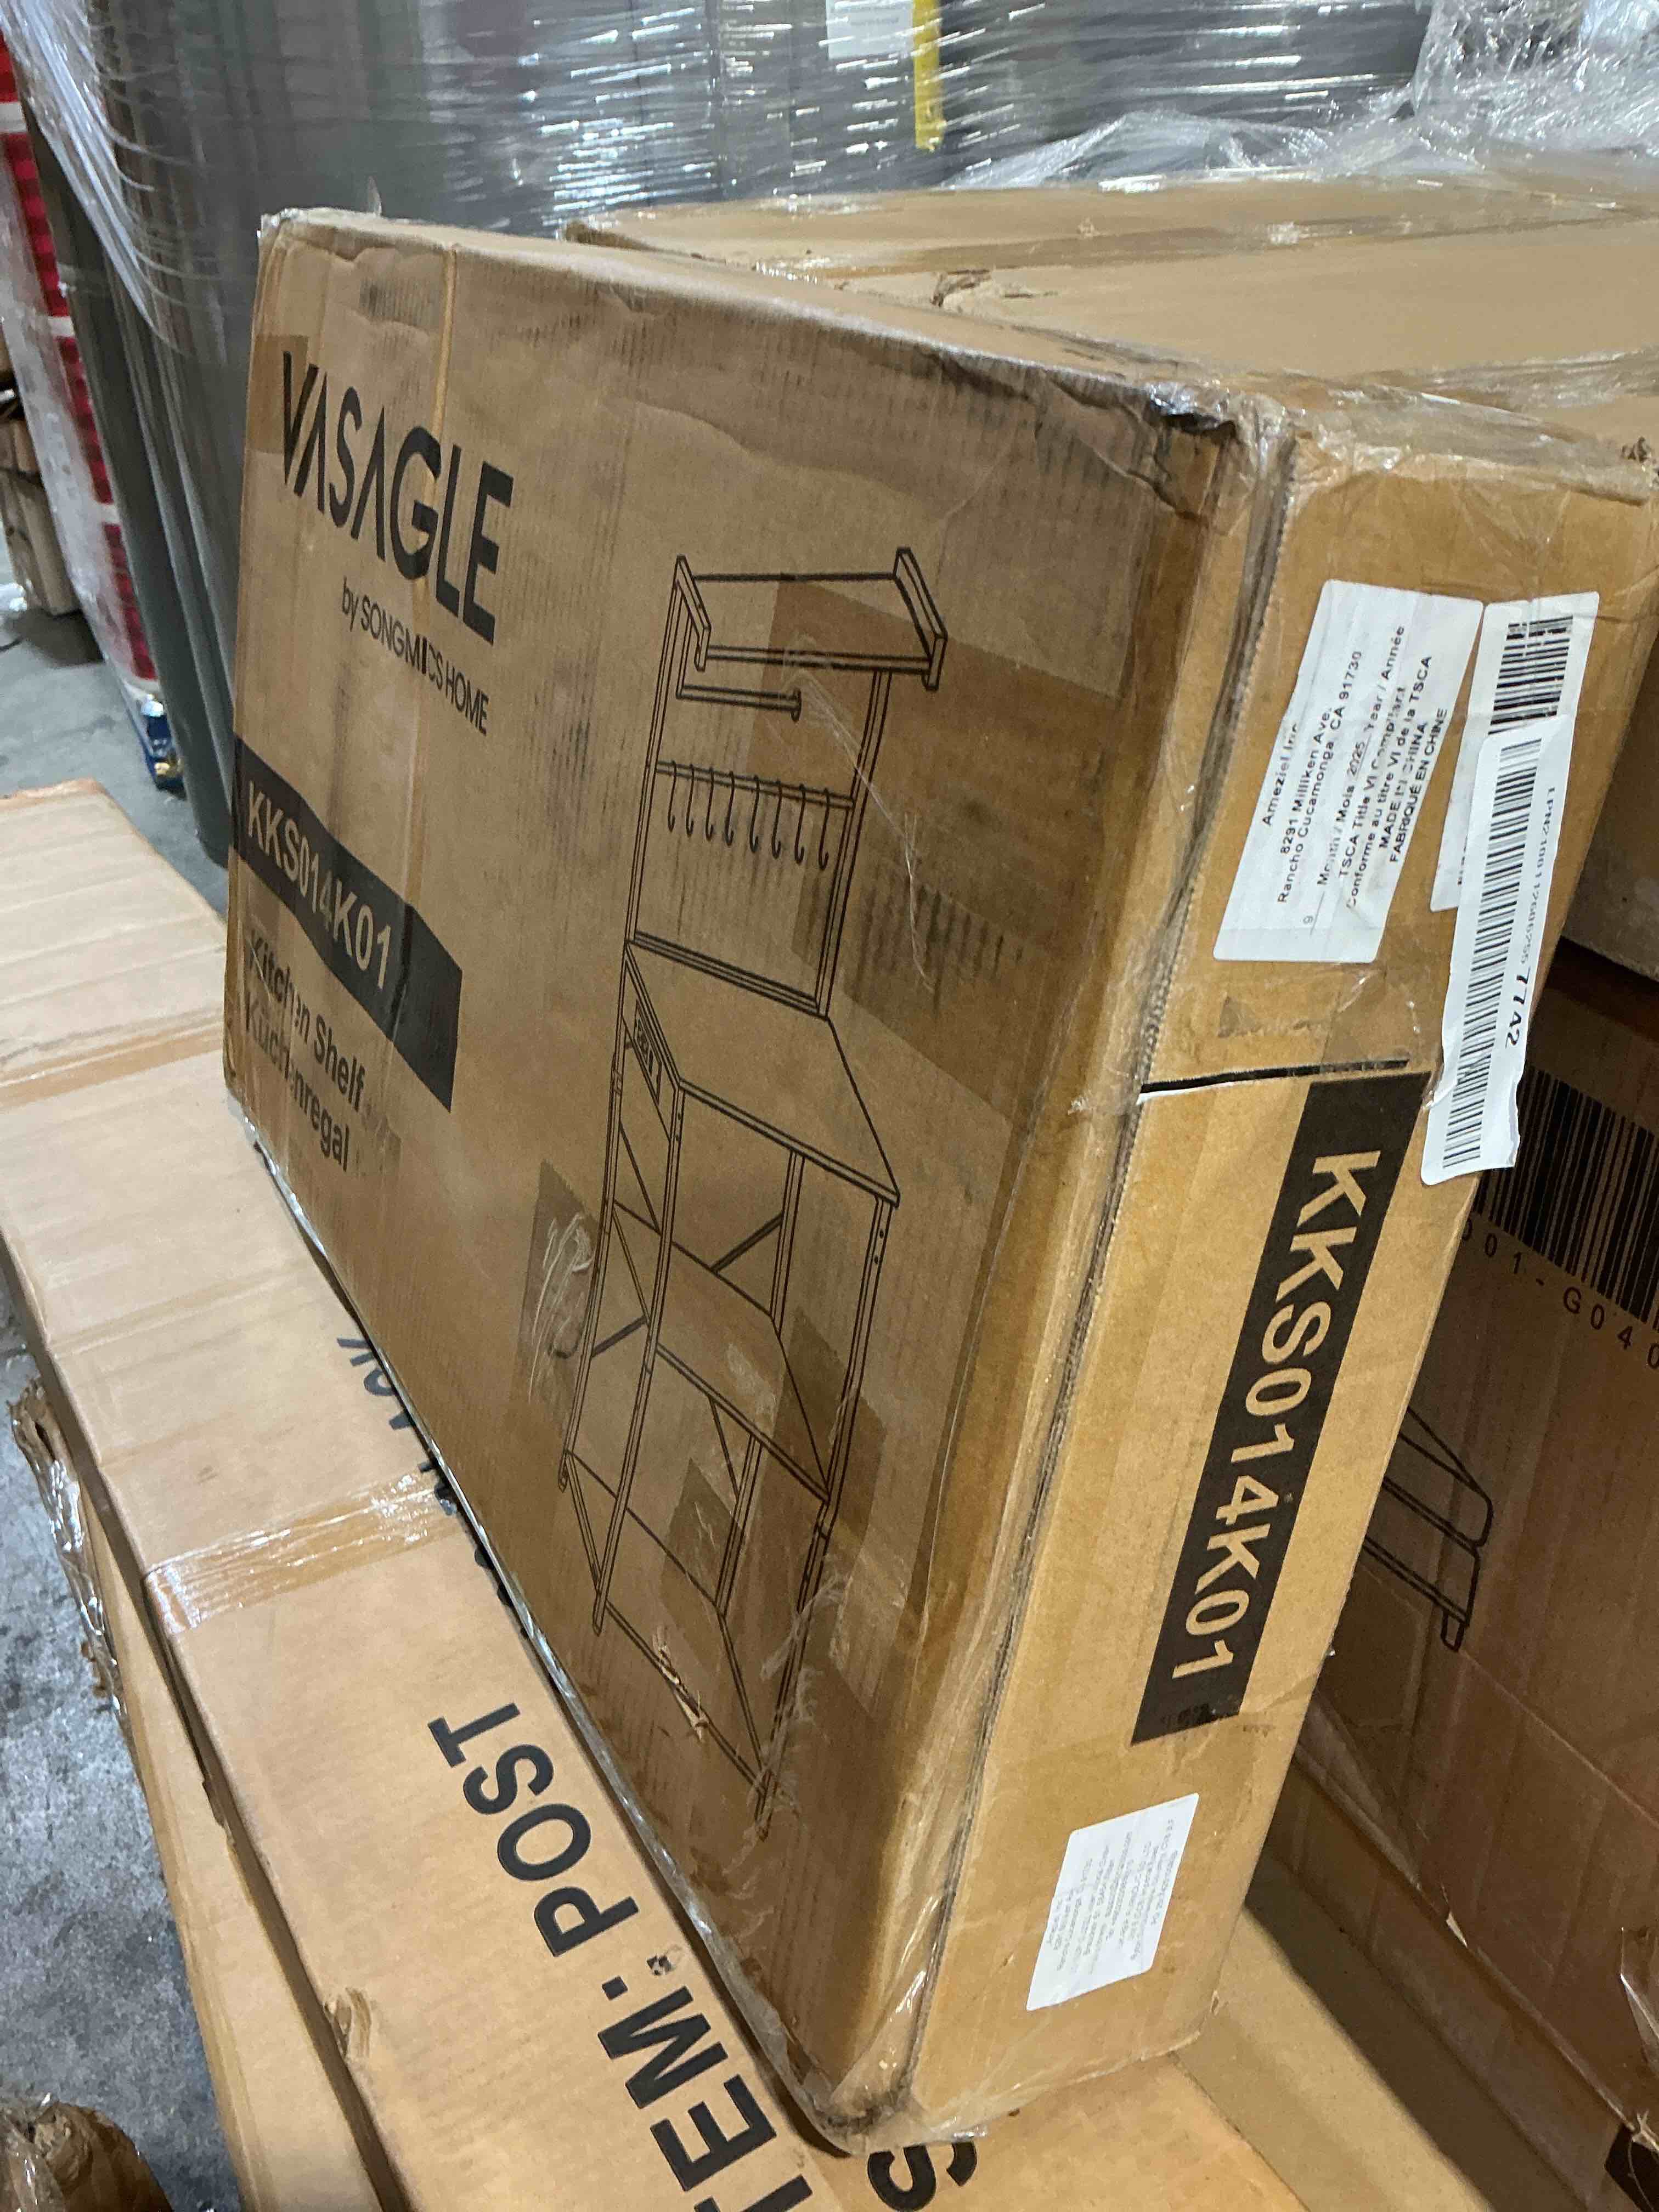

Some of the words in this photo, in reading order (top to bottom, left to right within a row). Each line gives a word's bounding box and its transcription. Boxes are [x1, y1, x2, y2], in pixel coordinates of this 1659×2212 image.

[283, 351, 513, 645] VASAGLE
[342, 578, 359, 633] by
[444, 661, 489, 736] HOME
[1380, 625, 1404, 680] Année
[1409, 655, 1432, 702] TSCA
[1278, 843, 1304, 902] Rancho
[1330, 706, 1345, 730] CA
[1339, 650, 1362, 700] 91730
[1389, 751, 1401, 766] VI
[1396, 727, 1409, 746] de
[1415, 760, 1429, 780] EN
[1424, 707, 1447, 755] CHINE
[1261, 756, 1291, 825] Ameziel
[1281, 819, 1298, 854] 8291
[1293, 750, 1318, 811] Milliken
[1339, 834, 1359, 877] TSCA
[1352, 796, 1369, 828] Title
[1364, 776, 1376, 790] VI
[1372, 808, 1383, 826] au
[1377, 772, 1393, 803] titre
[1379, 802, 1400, 848] MADE
[248, 781, 391, 990] KKS014K01
[314, 1014, 365, 1111] Shelf
[1172, 1149, 1381, 1679] KKS014K01
[428, 1702, 639, 1956] POST
